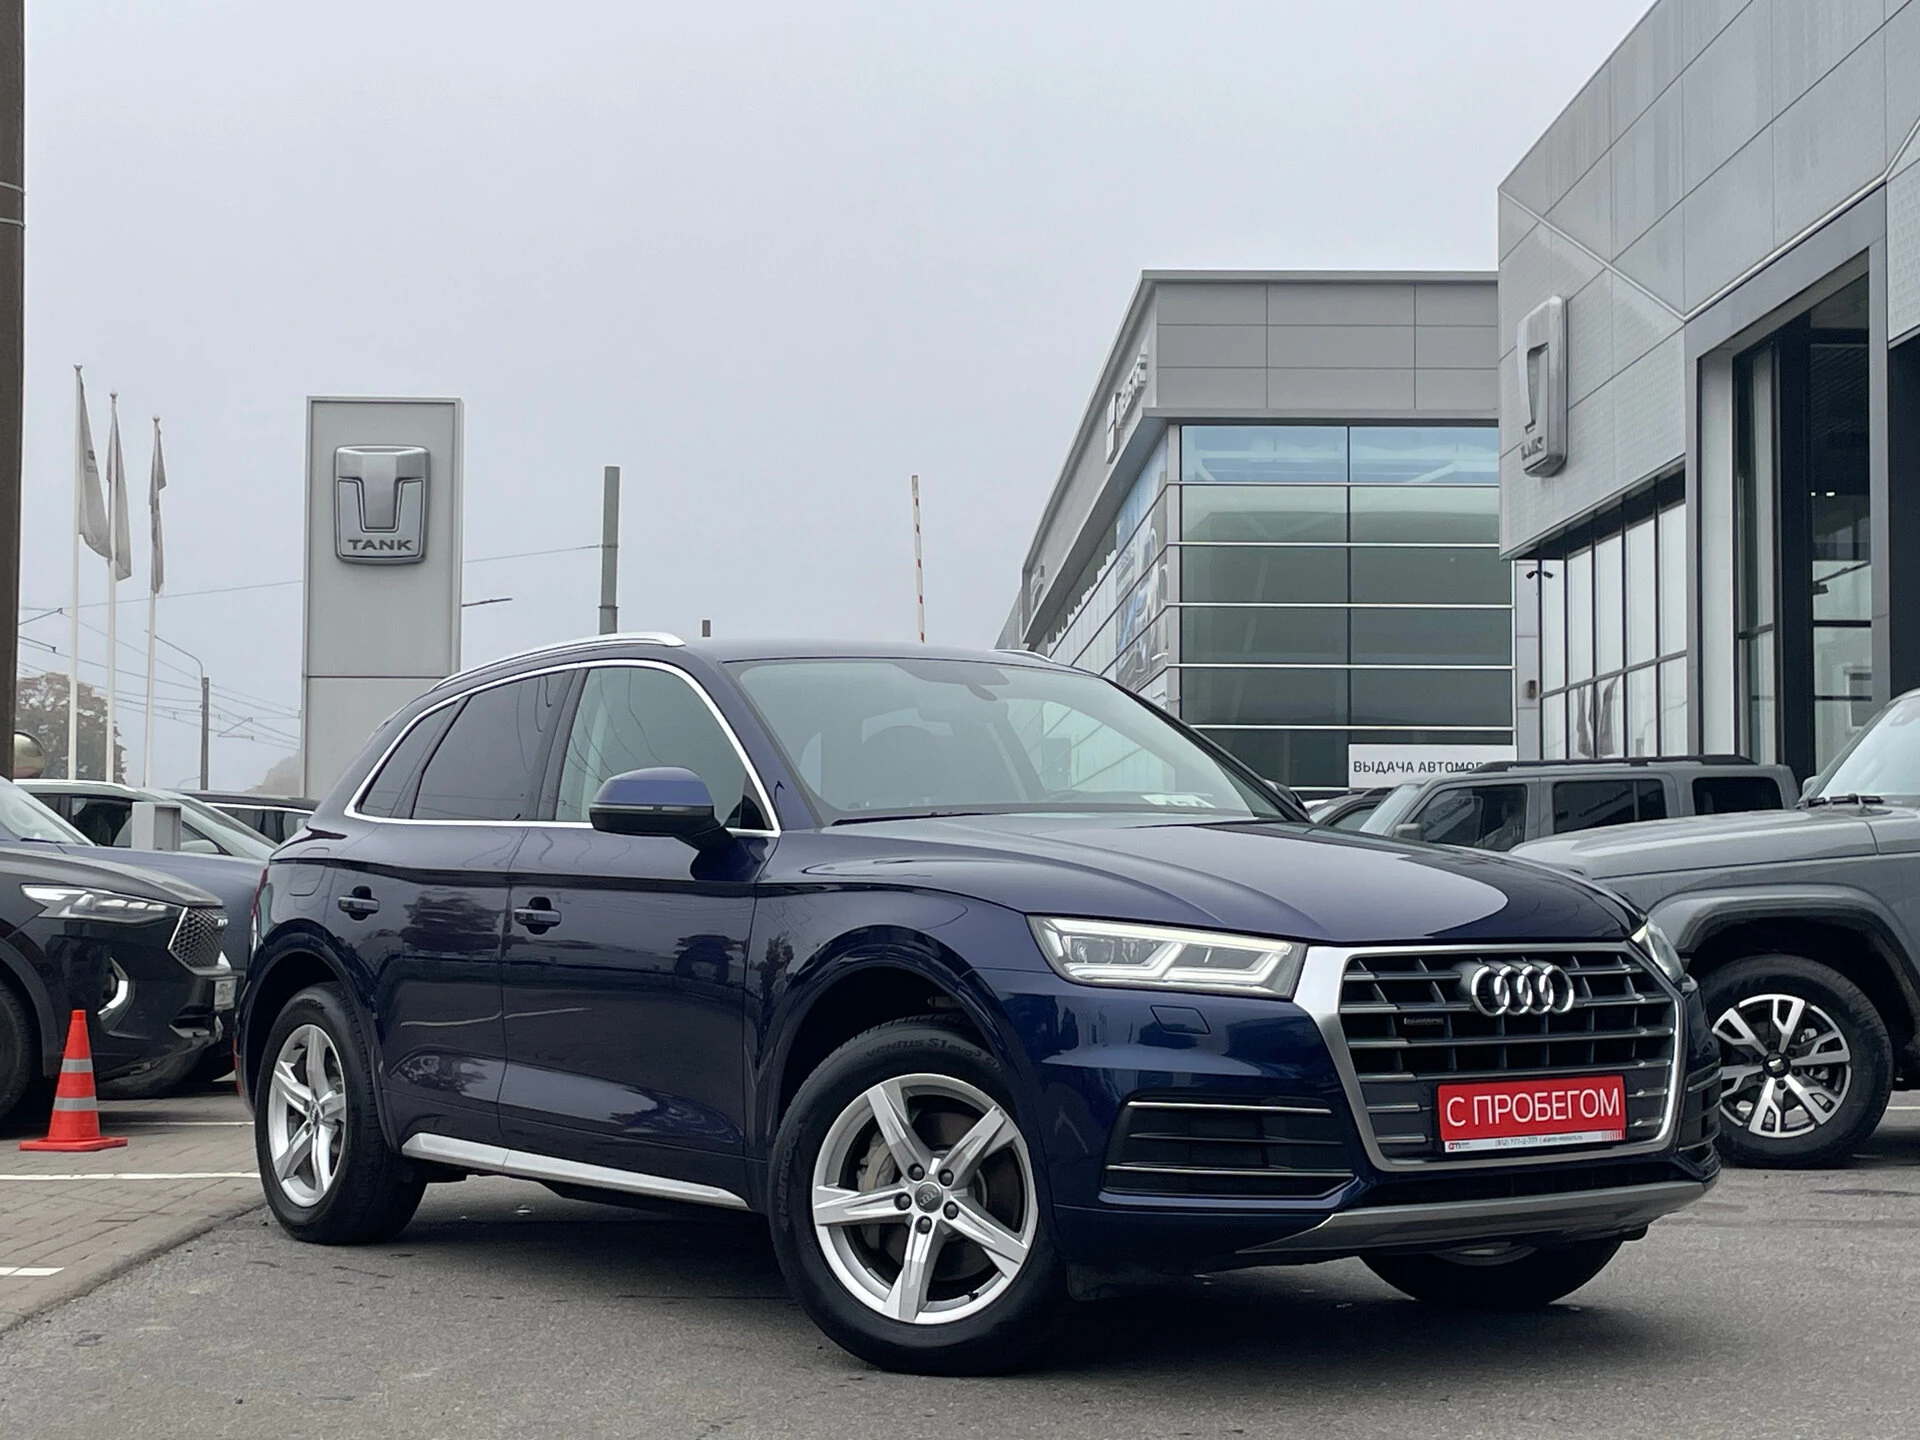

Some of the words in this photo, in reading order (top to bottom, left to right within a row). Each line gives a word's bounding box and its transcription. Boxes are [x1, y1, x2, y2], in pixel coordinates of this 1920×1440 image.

[347, 538, 413, 551] TANK
[1353, 760, 1415, 775] ВЫДАЧА
[1446, 1096, 1467, 1127] С
[1472, 1087, 1621, 1126] ПРОБЕГОМ
